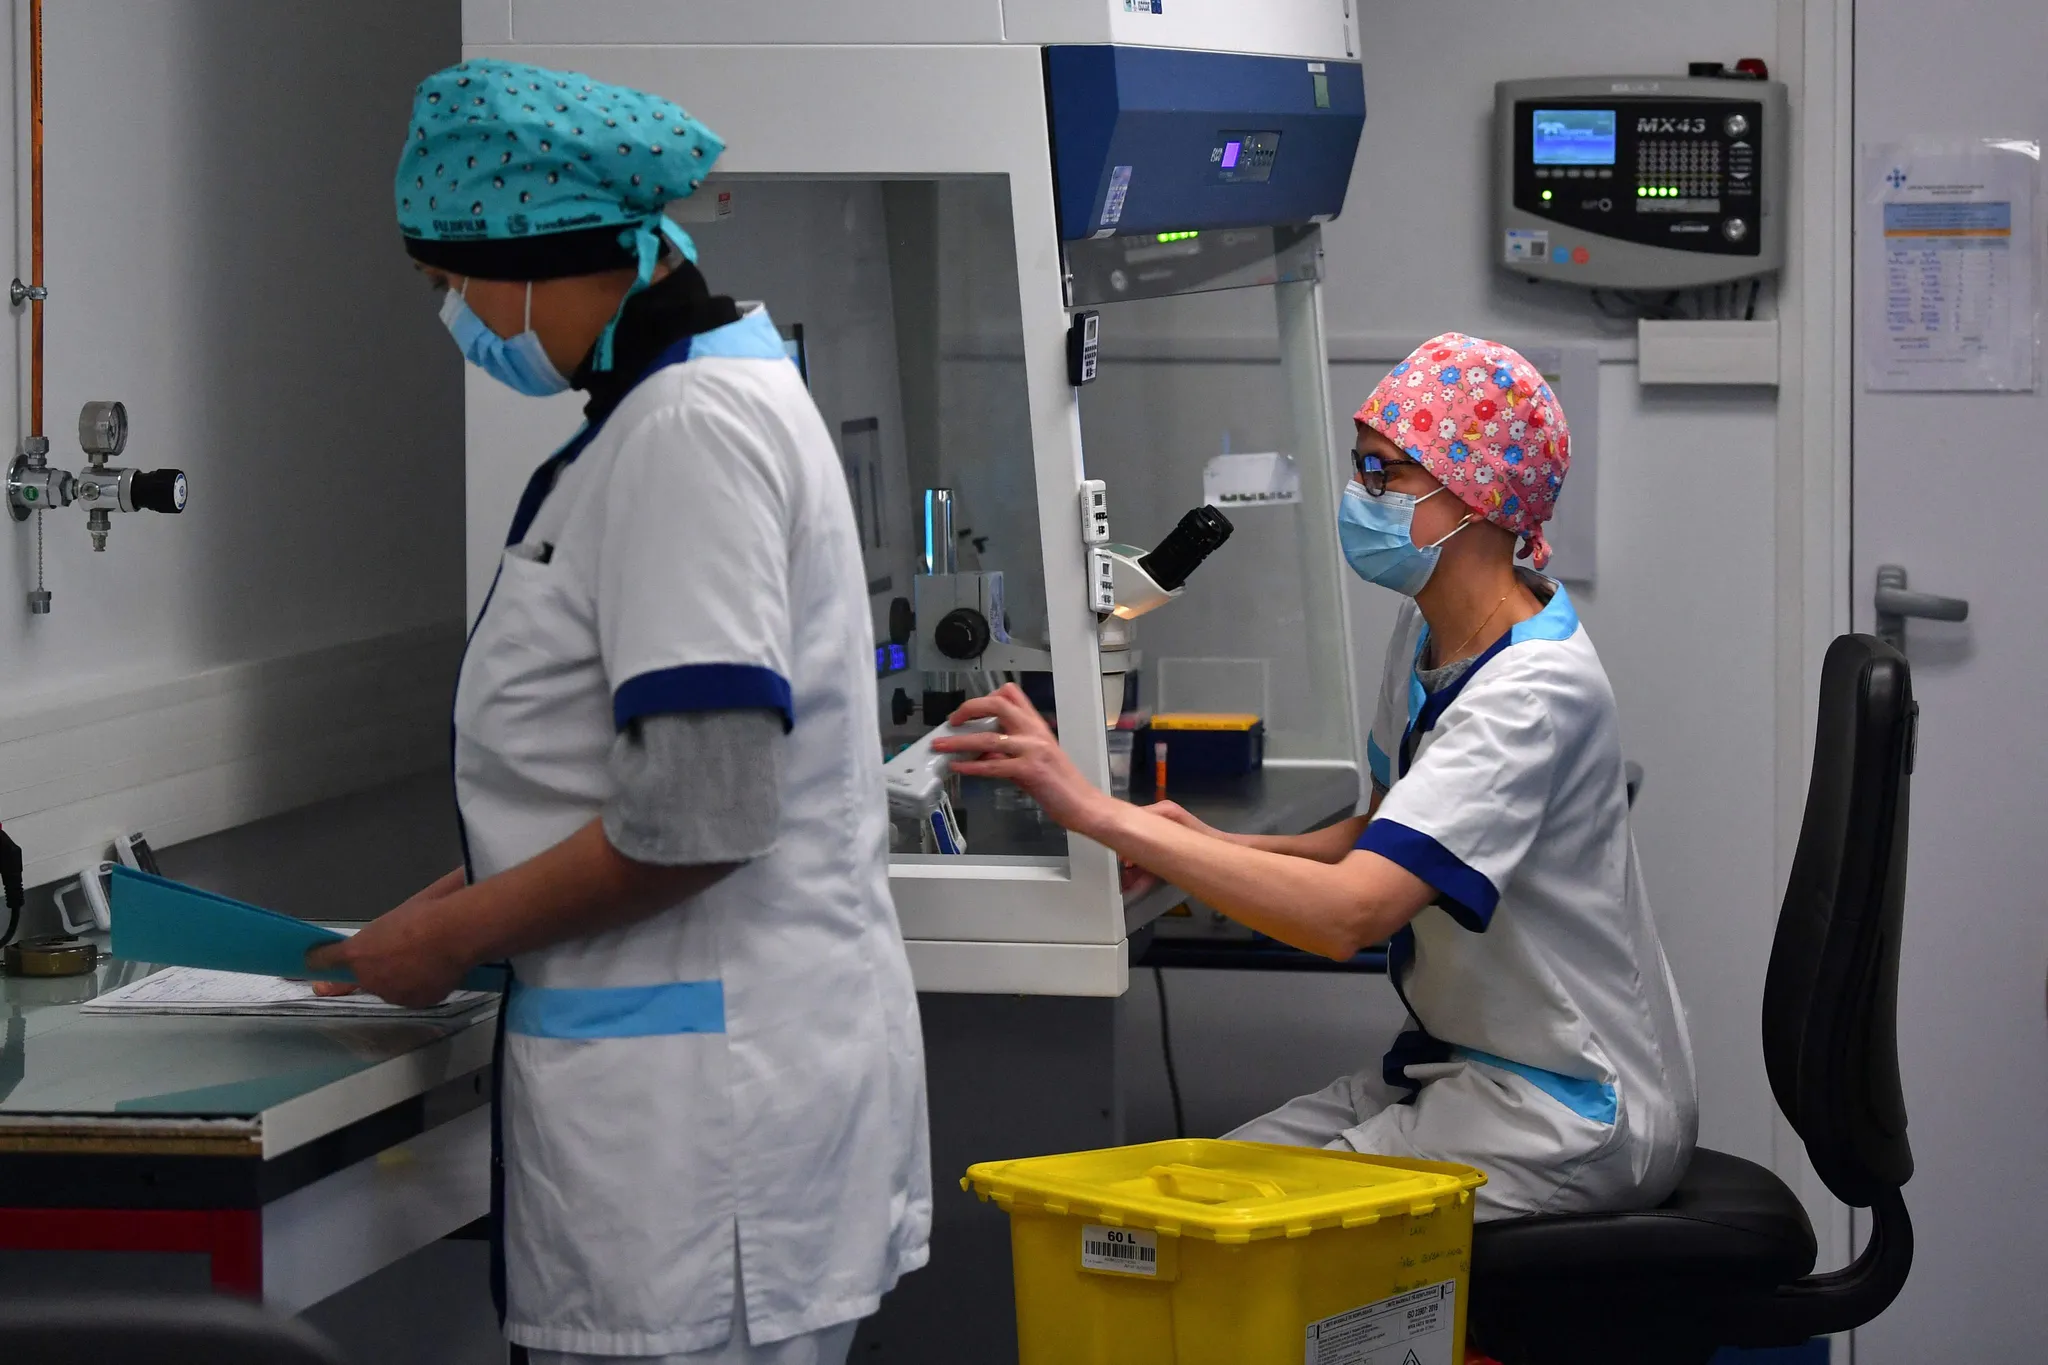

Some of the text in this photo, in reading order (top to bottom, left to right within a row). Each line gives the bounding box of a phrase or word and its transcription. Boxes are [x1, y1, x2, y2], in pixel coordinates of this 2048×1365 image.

[1637, 117, 1706, 133] MX43
[1107, 1230, 1136, 1244] 60 L
